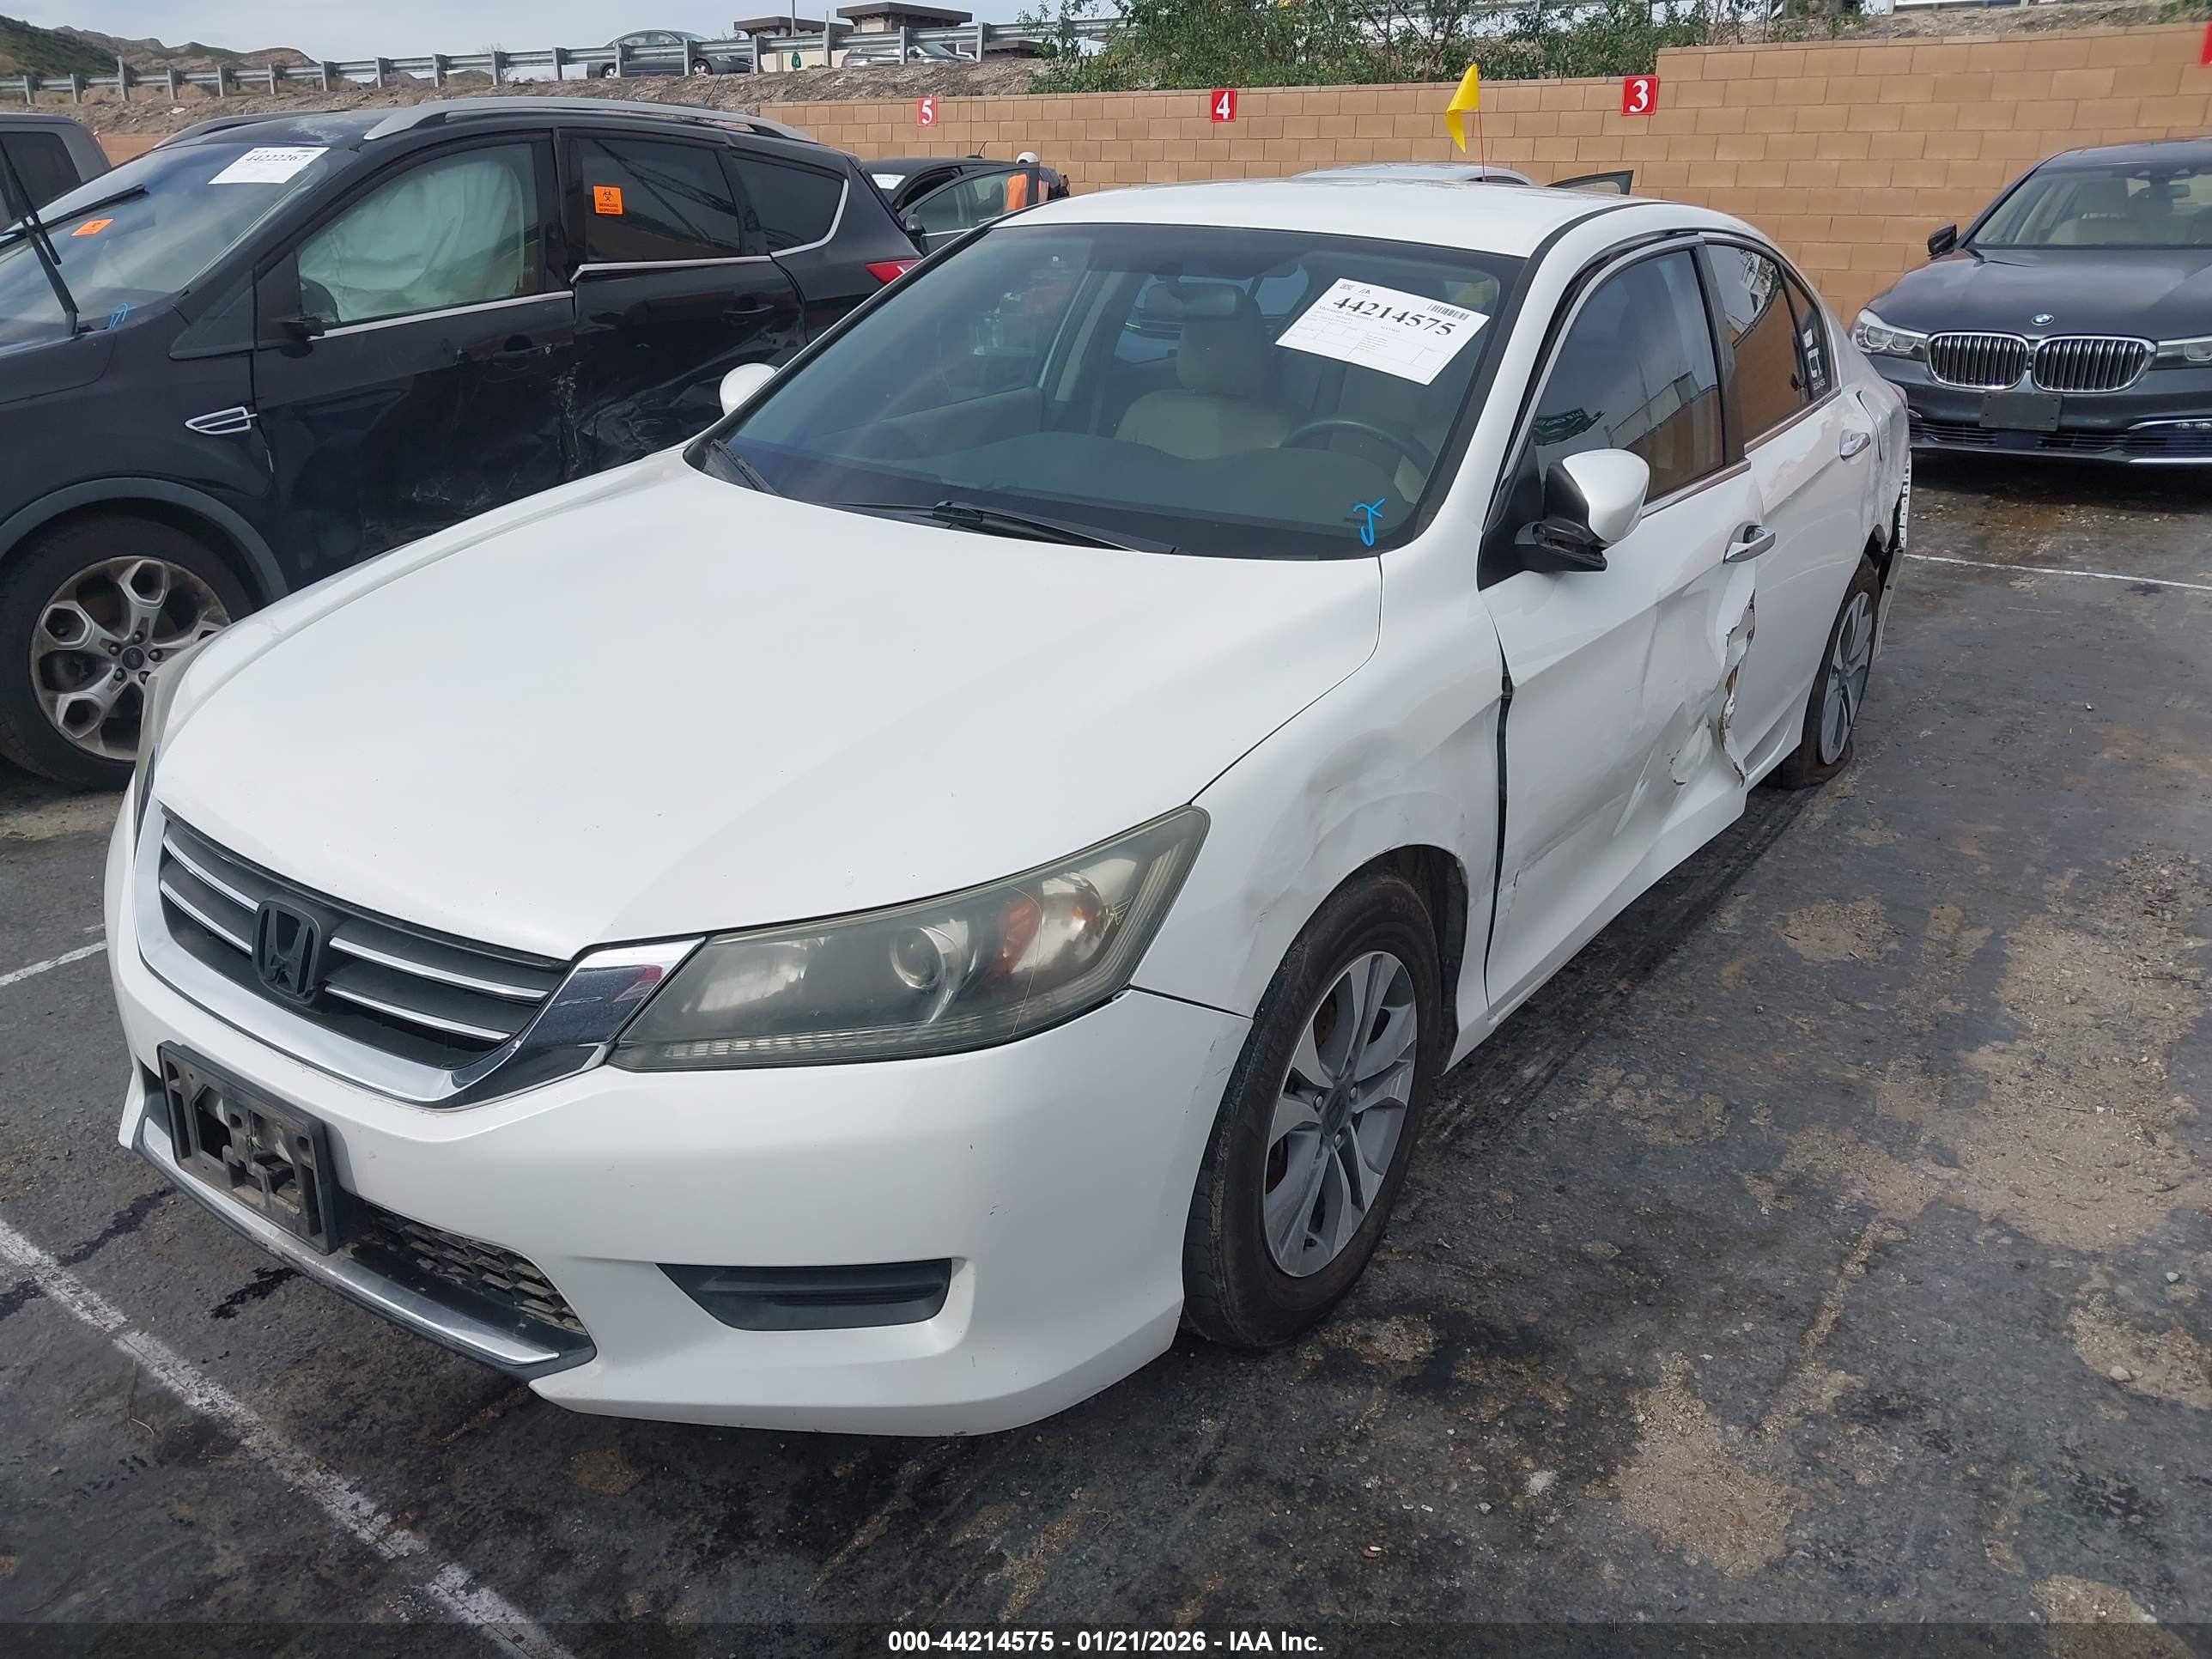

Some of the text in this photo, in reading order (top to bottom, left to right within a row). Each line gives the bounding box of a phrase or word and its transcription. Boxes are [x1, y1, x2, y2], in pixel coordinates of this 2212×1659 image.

[1215, 91, 1231, 119] 4
[1629, 79, 1649, 112] 3
[921, 99, 933, 125] 5
[1333, 296, 1457, 337] 44214575
